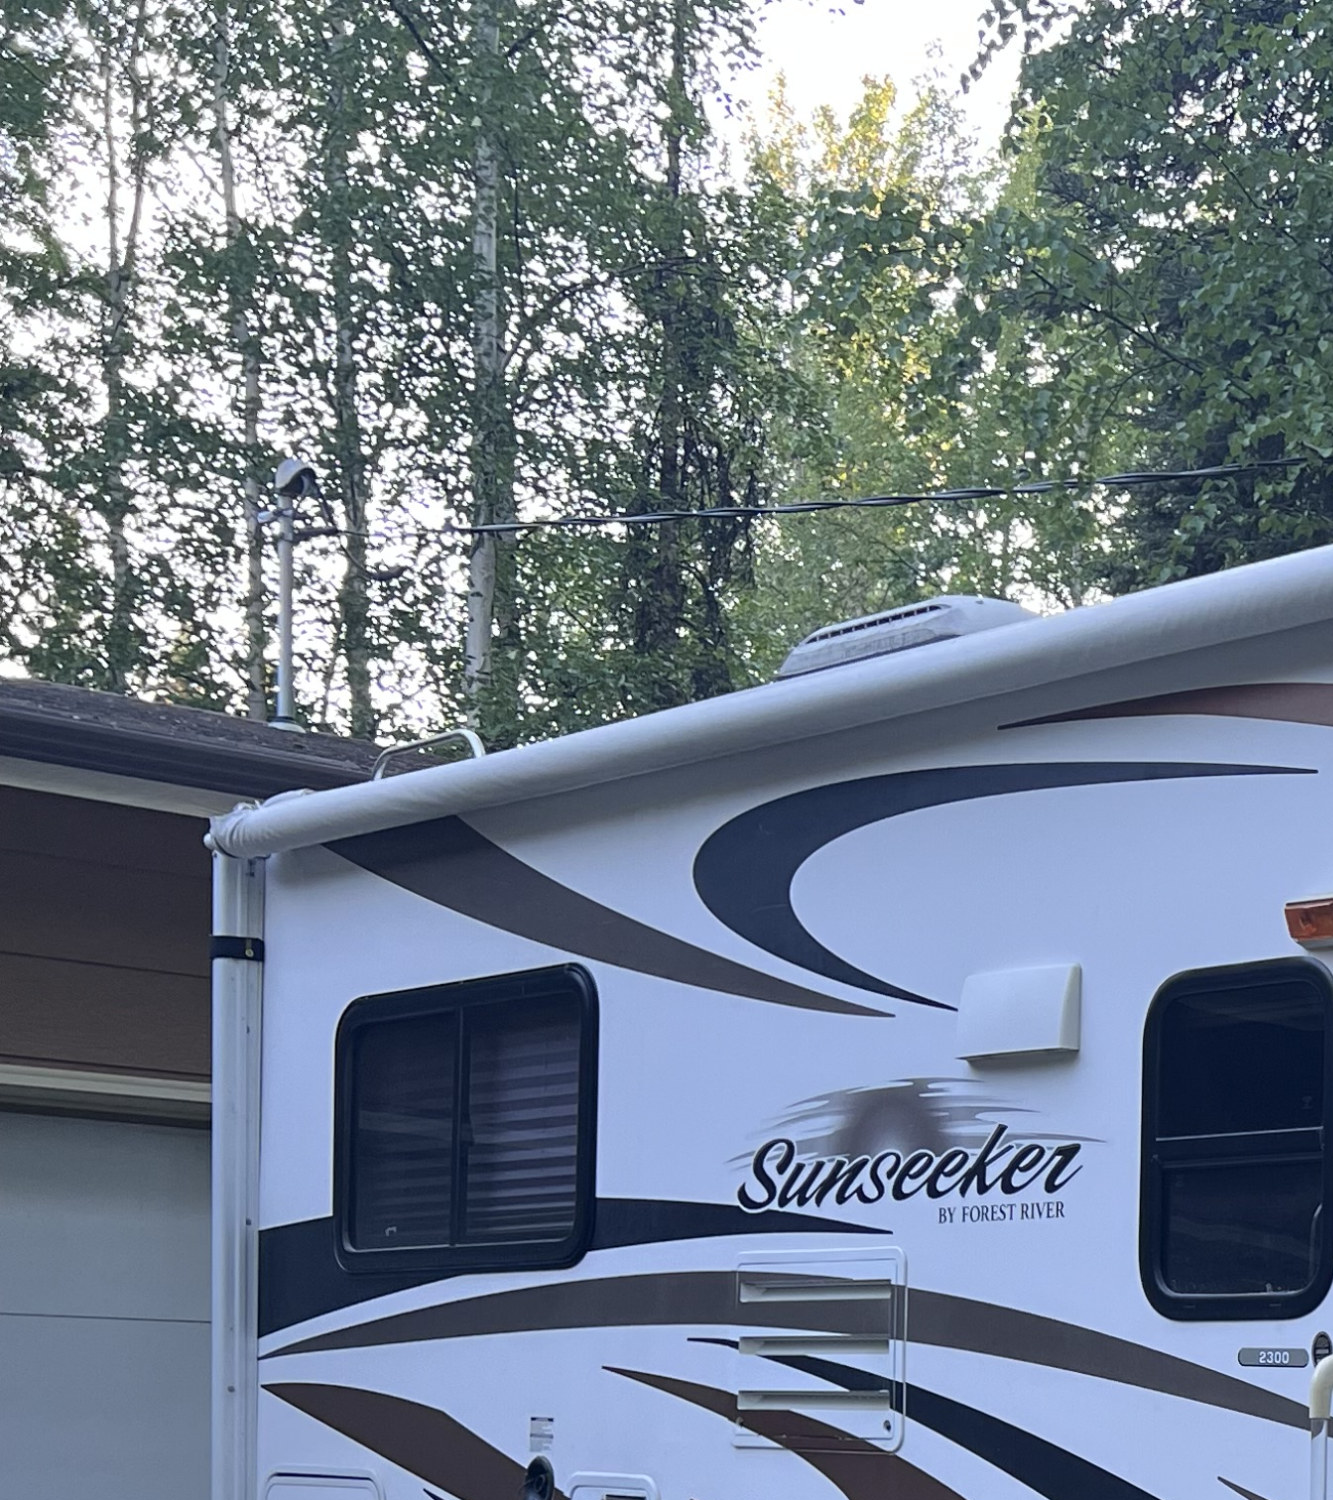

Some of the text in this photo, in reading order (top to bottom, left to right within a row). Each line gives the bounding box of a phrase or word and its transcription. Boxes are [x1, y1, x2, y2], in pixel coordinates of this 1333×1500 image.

[736, 1122, 1084, 1212] Sunseeker
[938, 1200, 1065, 1224] BY FOREST RIVER
[1259, 1350, 1290, 1364] 2300
